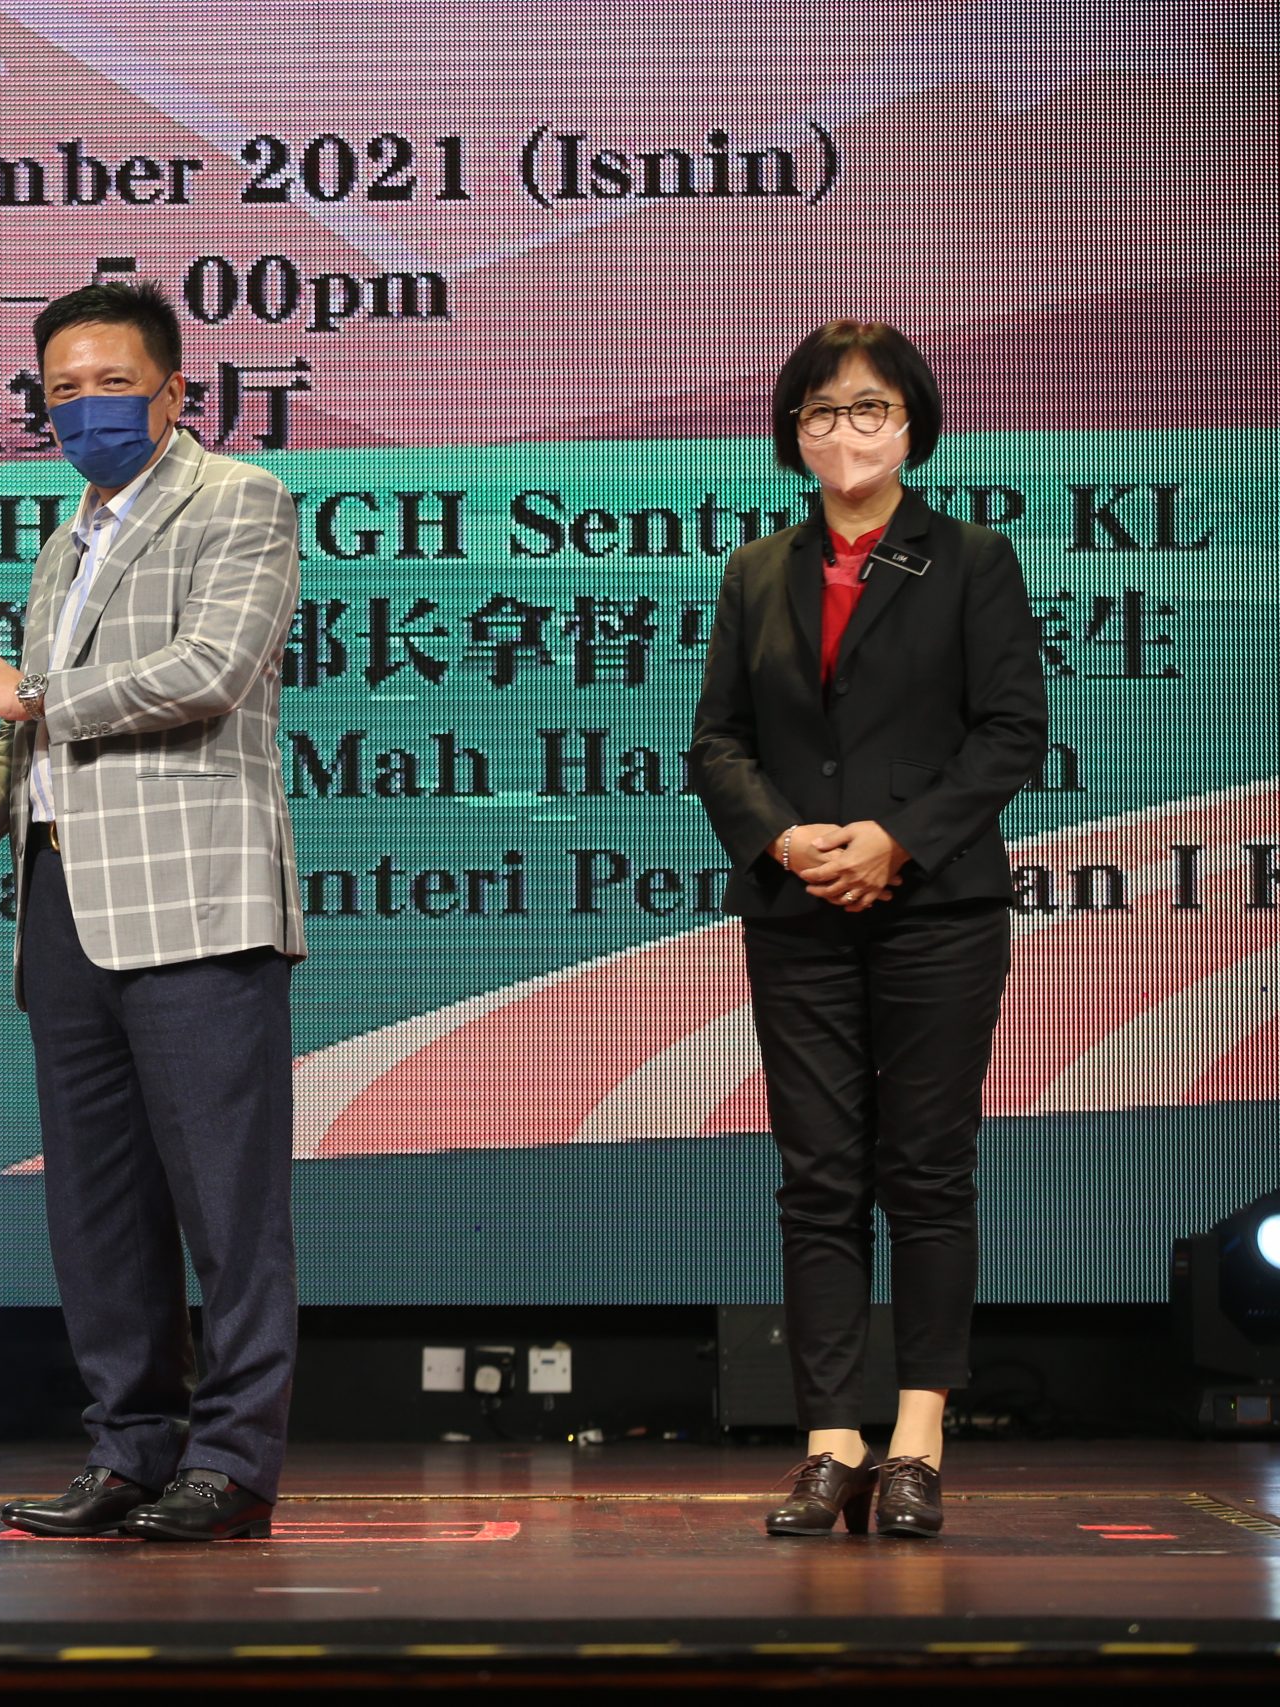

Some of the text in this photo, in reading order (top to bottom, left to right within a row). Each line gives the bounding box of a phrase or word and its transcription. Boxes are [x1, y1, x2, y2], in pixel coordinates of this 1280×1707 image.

[240, 133, 472, 202] 2021
[521, 122, 840, 208] (Isnin)
[93, 253, 451, 333] 00pm
[292, 490, 468, 560] GH
[1066, 482, 1214, 552] KL
[288, 728, 494, 800] Mah
[303, 851, 527, 917] nteri
[1171, 844, 1203, 910] I
